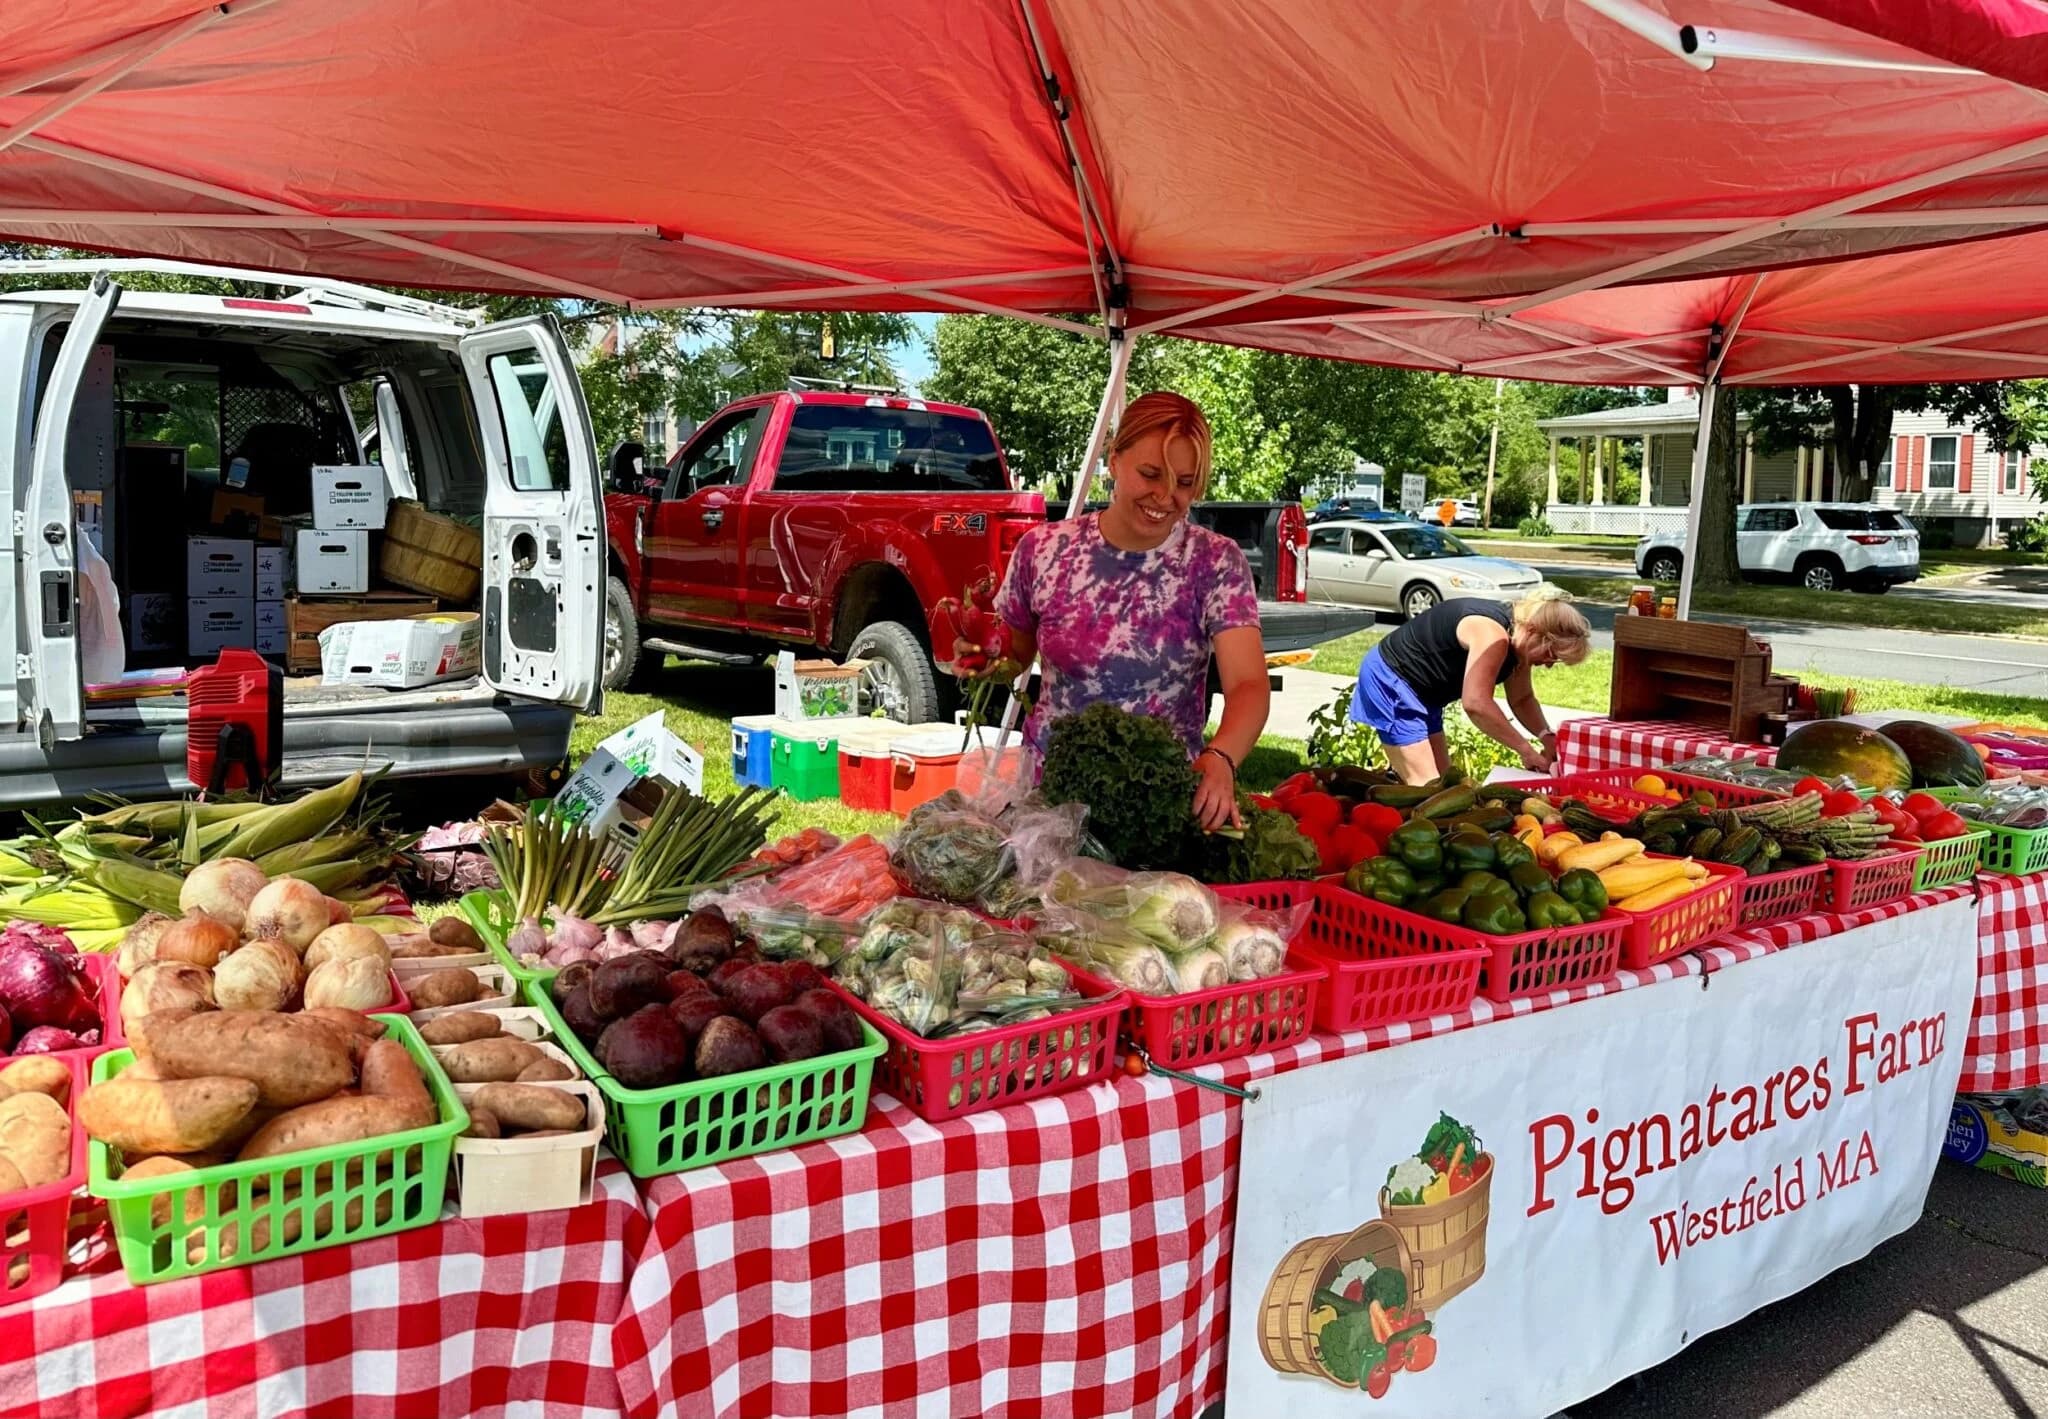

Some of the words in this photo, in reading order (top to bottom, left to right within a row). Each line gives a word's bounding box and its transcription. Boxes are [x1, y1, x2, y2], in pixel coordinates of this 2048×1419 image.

[1404, 477, 1424, 486] RIGHT
[1404, 488, 1423, 497] TURN
[1403, 499, 1421, 508] ONLY
[932, 513, 987, 533] FX4
[1527, 1056, 1832, 1217] Pignatares
[1843, 1011, 1946, 1096] Farm
[1947, 1119, 1975, 1139] den
[1943, 1131, 1970, 1153] ley
[1649, 1156, 1807, 1266] Westfield
[1816, 1130, 1880, 1201] MA
